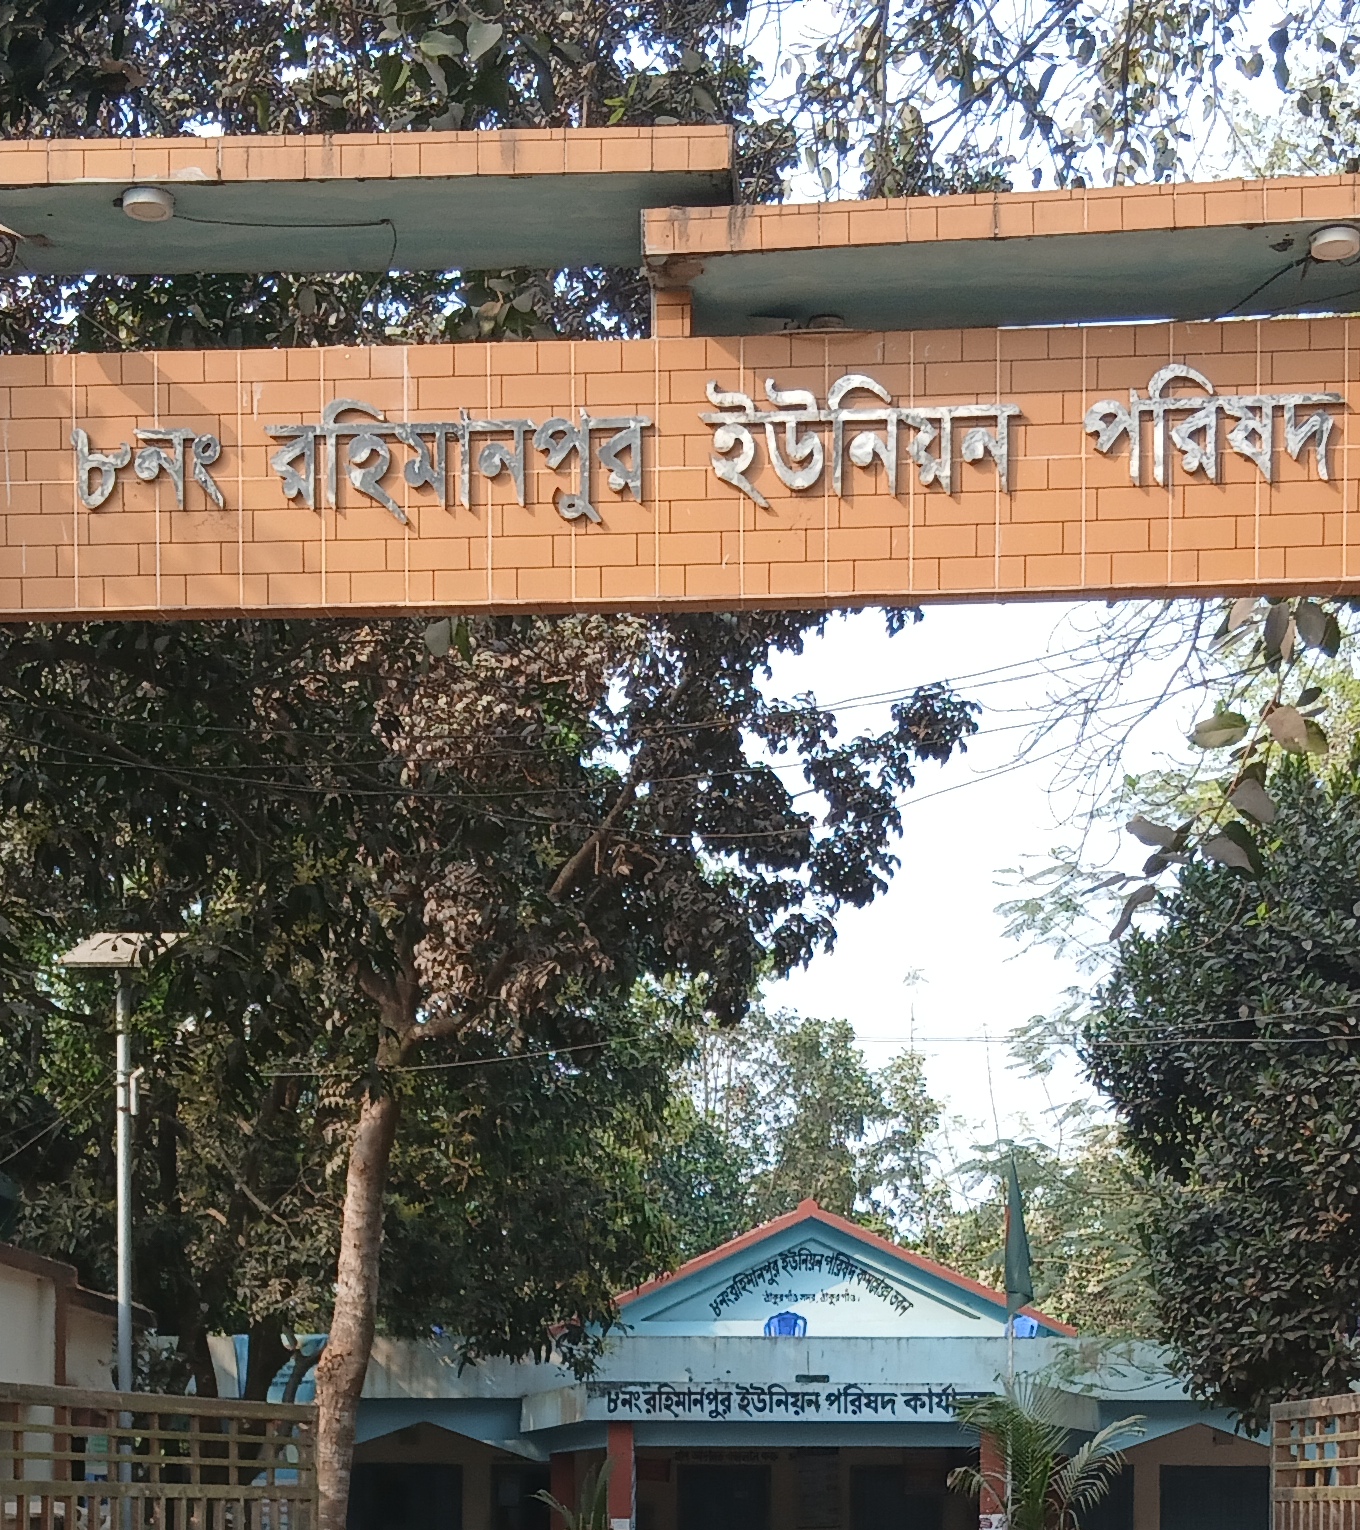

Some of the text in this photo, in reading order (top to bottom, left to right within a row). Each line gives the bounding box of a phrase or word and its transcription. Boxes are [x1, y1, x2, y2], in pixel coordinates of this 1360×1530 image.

[71, 363, 1346, 524] ৮নং রহিমানপুর ইউনিয়ন পরিষদ
[780, 1248, 824, 1277] ইউনিয়ন
[824, 1252, 857, 1284] পরিষদ
[642, 1382, 732, 1419] রহিমানপুর
[735, 1382, 821, 1417] ইউনিয়ন
[825, 1383, 898, 1416] পরিষদ
